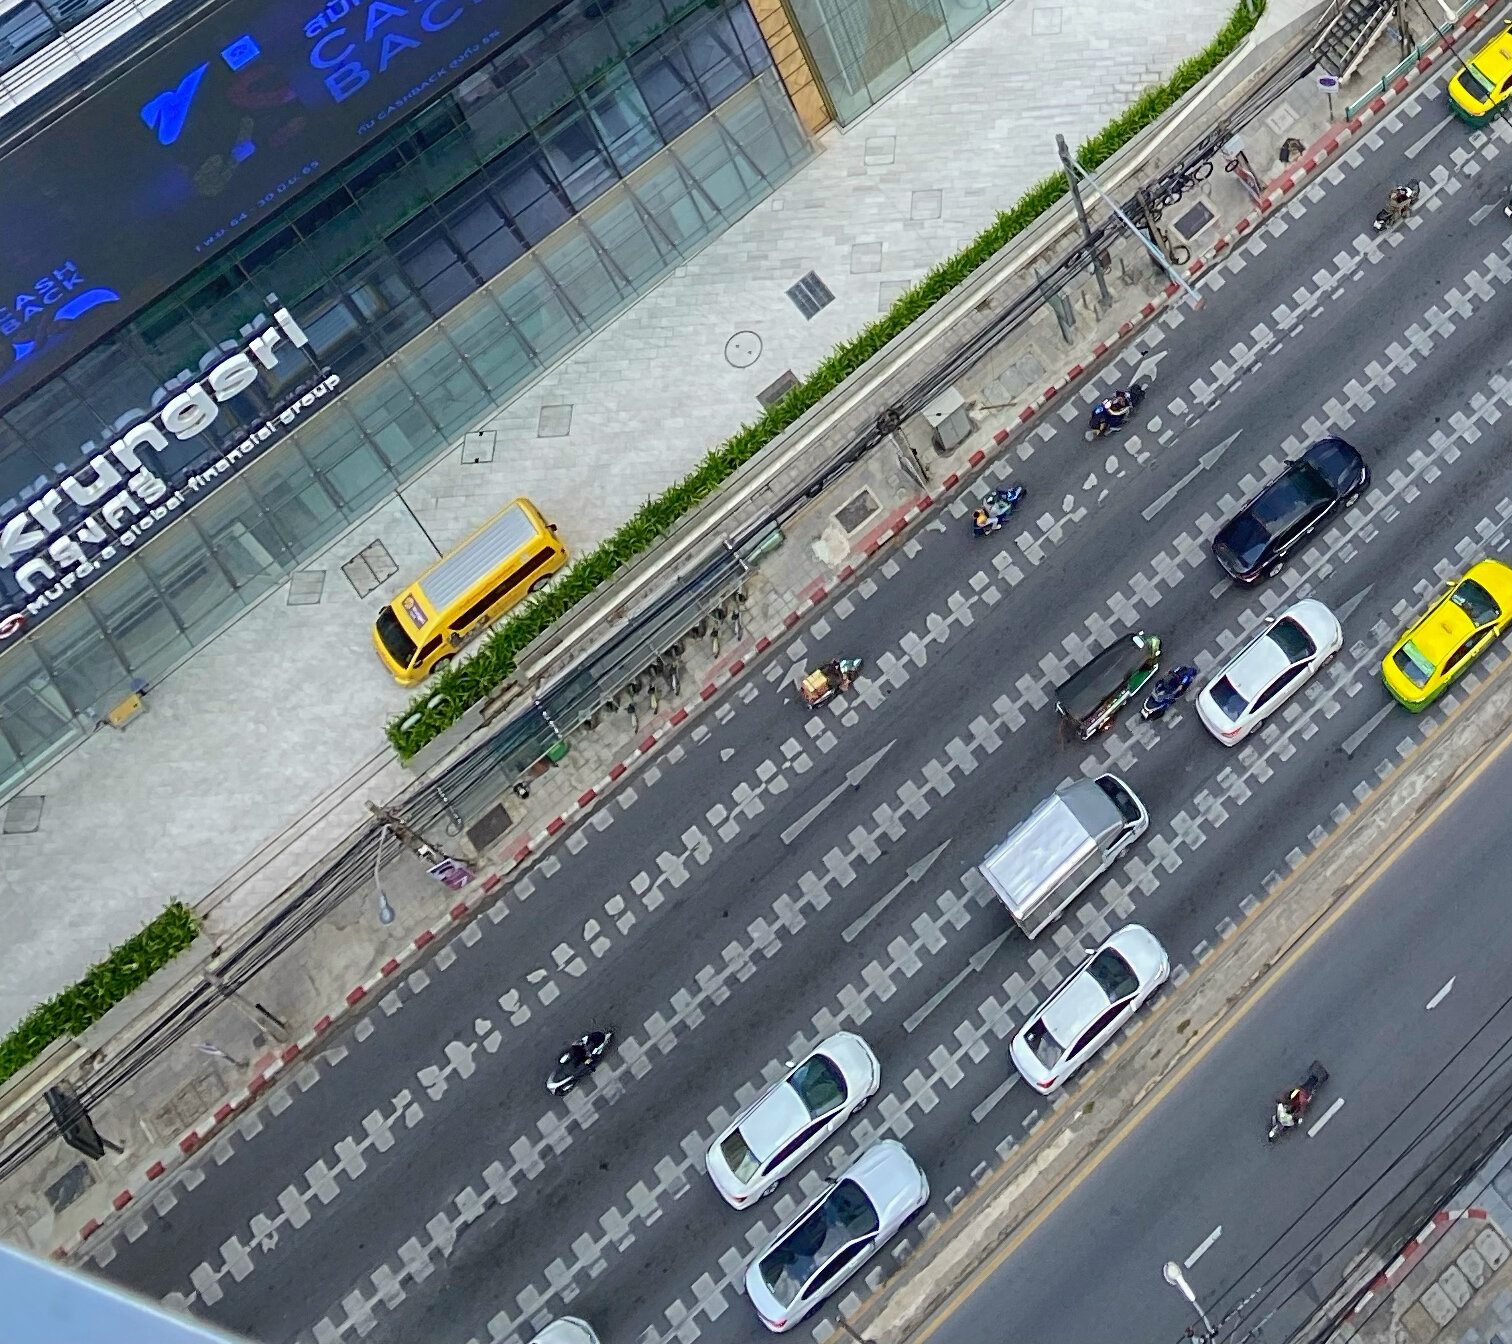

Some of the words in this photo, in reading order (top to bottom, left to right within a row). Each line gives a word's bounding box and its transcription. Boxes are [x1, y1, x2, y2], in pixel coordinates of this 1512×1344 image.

[0, 307, 309, 570] krungsri
[119, 490, 186, 547] global
[279, 374, 341, 425] group
[15, 464, 167, 595] กรุงศรี
